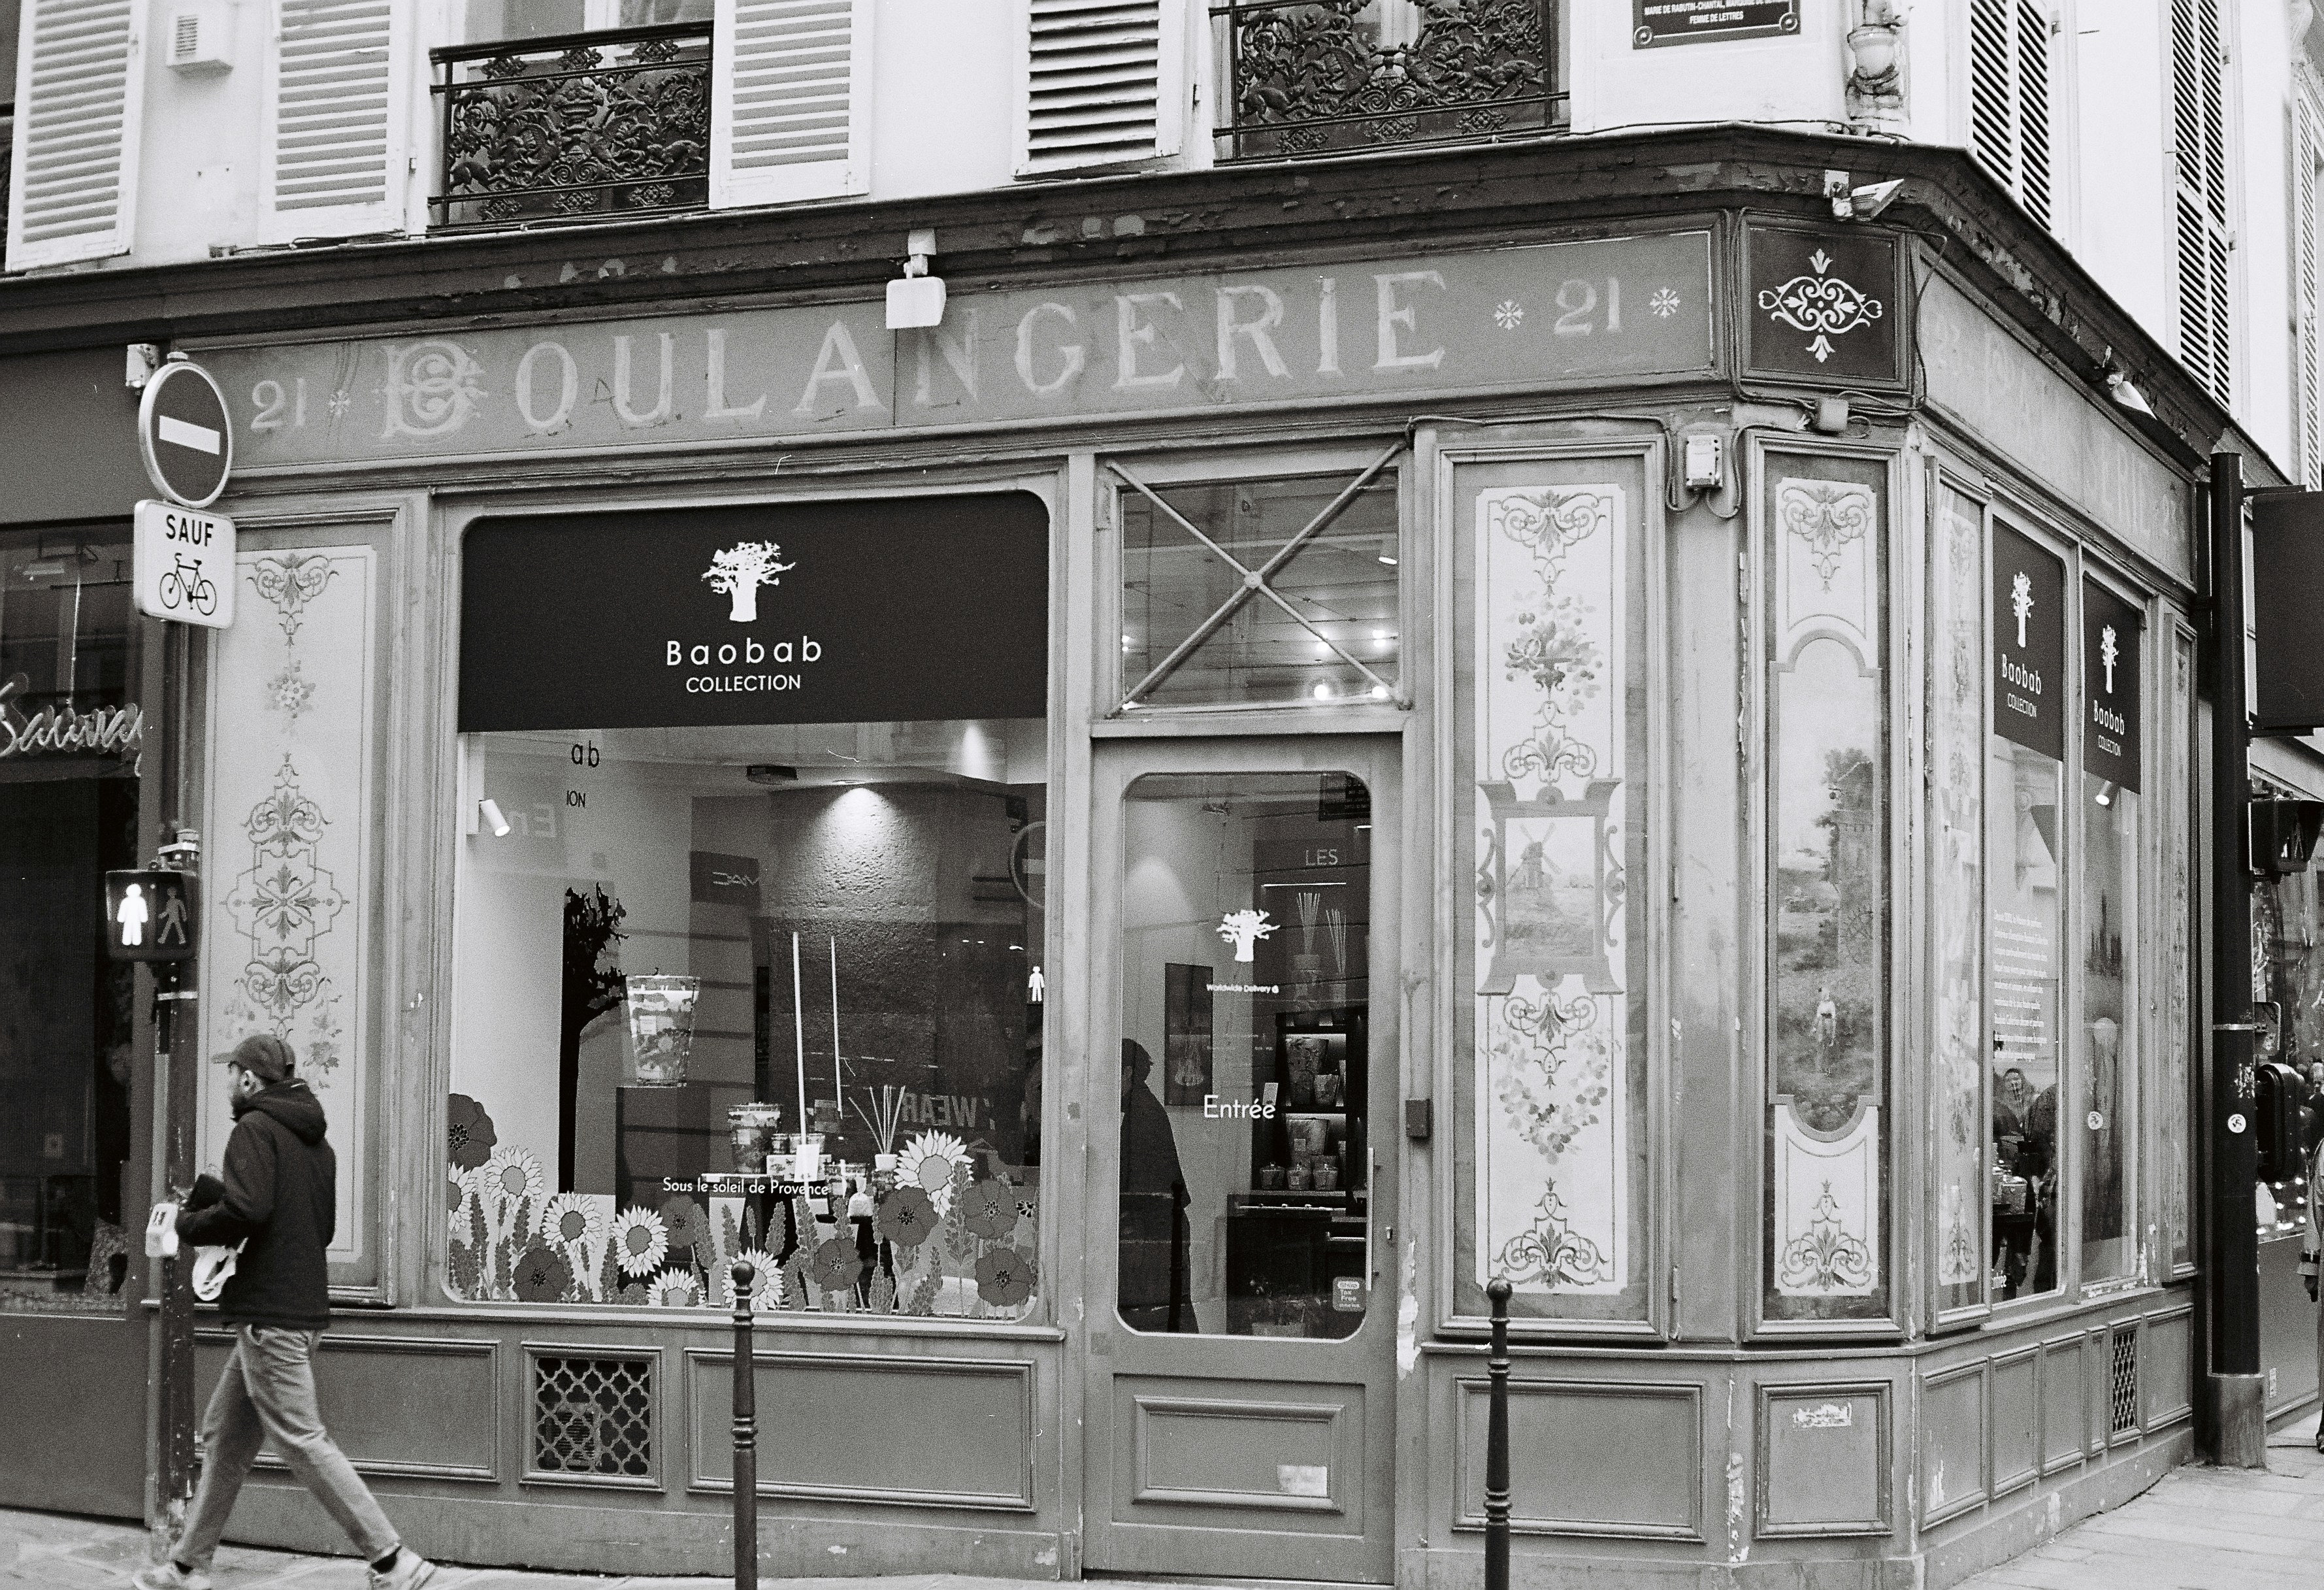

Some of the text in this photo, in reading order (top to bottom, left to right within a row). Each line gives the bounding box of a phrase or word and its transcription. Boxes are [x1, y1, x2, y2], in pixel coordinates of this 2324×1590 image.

[1645, 5, 1662, 15] MARIE
[1663, 5, 1671, 14] DE
[1690, 10, 1744, 24] FEMME DE LETTRES
[251, 270, 1622, 440] 21 BOULANGERIE 21
[166, 514, 214, 547] SAUF
[666, 635, 821, 666] Baobab
[686, 674, 800, 693] COLLECTION
[2002, 654, 2041, 695] Baobab
[2008, 692, 2037, 718] COLLECTION
[2094, 700, 2124, 735] Baobab
[571, 740, 600, 768] ab
[2098, 735, 2121, 756] COLLECTION
[566, 789, 586, 808] ION
[1305, 849, 1339, 866] LES
[1206, 984, 1243, 992] Worldwide
[1204, 1095, 1276, 1119] Entrée
[663, 1177, 829, 1195] Sous le soleil de Provence
